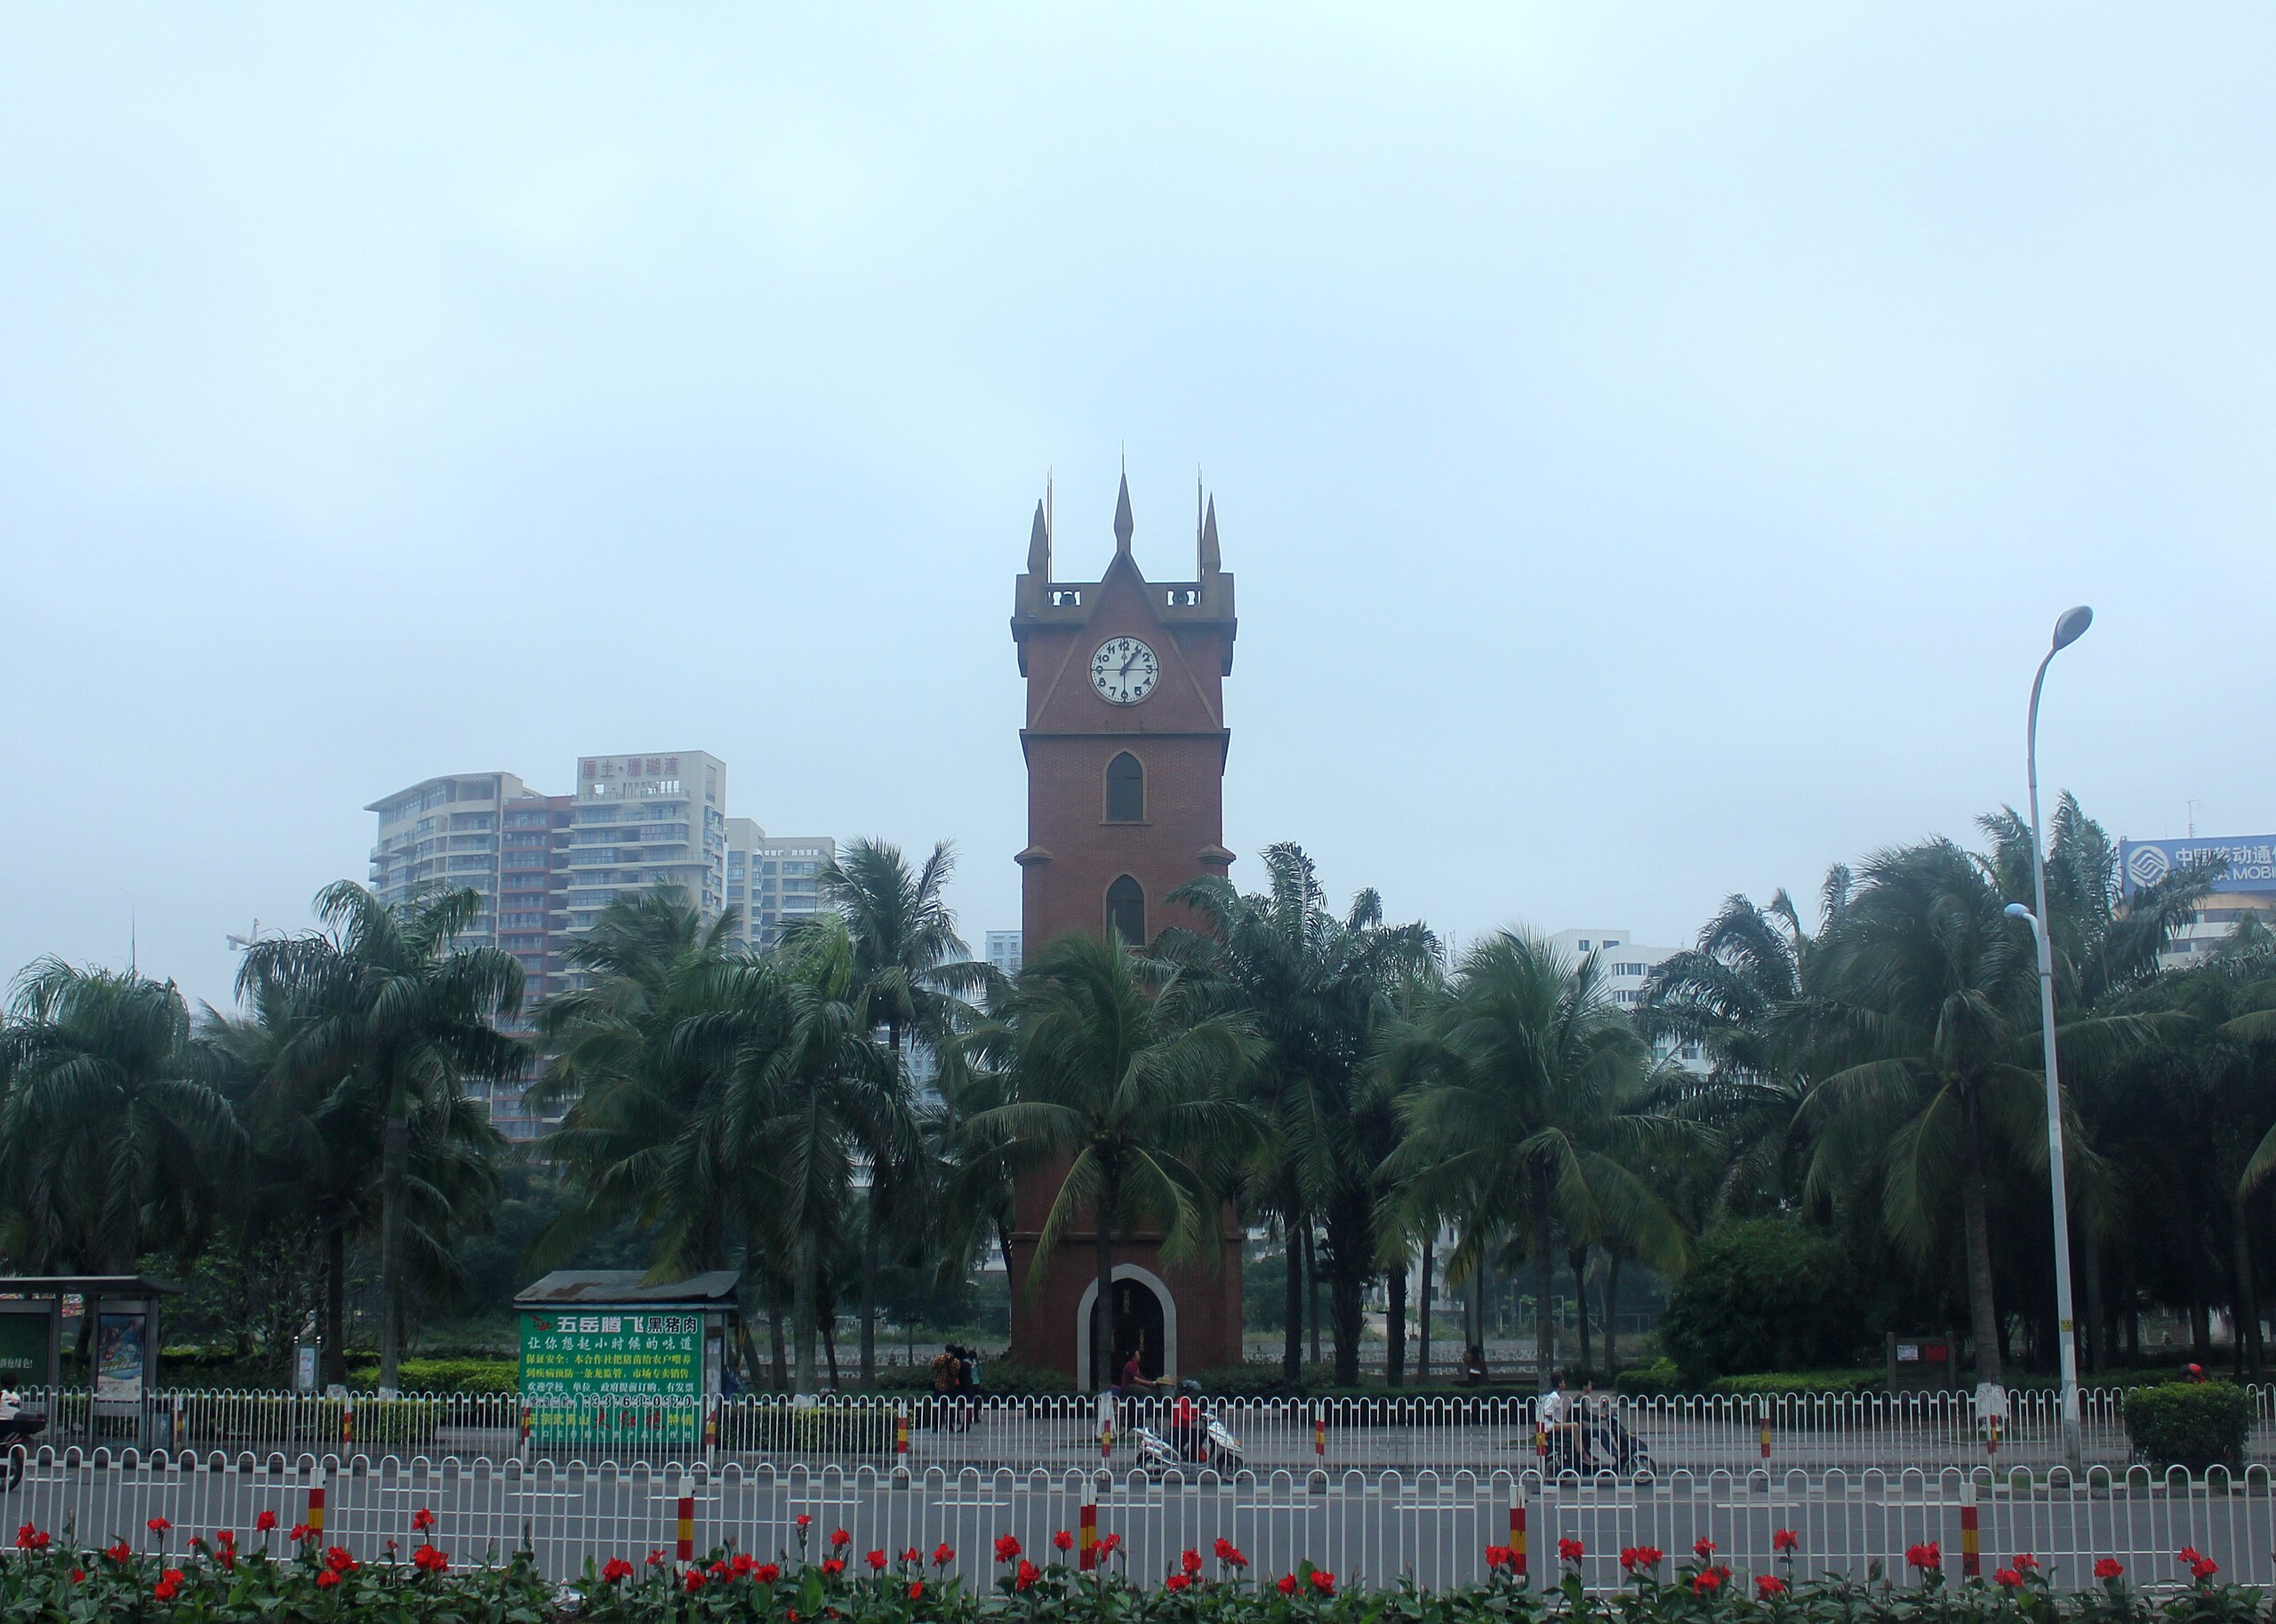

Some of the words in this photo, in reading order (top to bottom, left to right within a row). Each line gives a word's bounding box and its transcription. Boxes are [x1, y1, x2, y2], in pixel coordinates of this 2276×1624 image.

[1107, 644, 1115, 653] 11
[1118, 640, 1130, 651] 12
[1098, 654, 1110, 663] 10
[1142, 652, 1150, 662] 2
[1096, 665, 1103, 675] 9
[1146, 665, 1153, 674] 3
[1099, 677, 1106, 687] 8
[1142, 676, 1151, 686] 4
[1110, 687, 1117, 697] 7
[1120, 689, 1128, 699] 6
[1134, 687, 1142, 696] 5
[2232, 867, 2276, 881] MOBI
[527, 1336, 693, 1350] 让你想起小时候的味道
